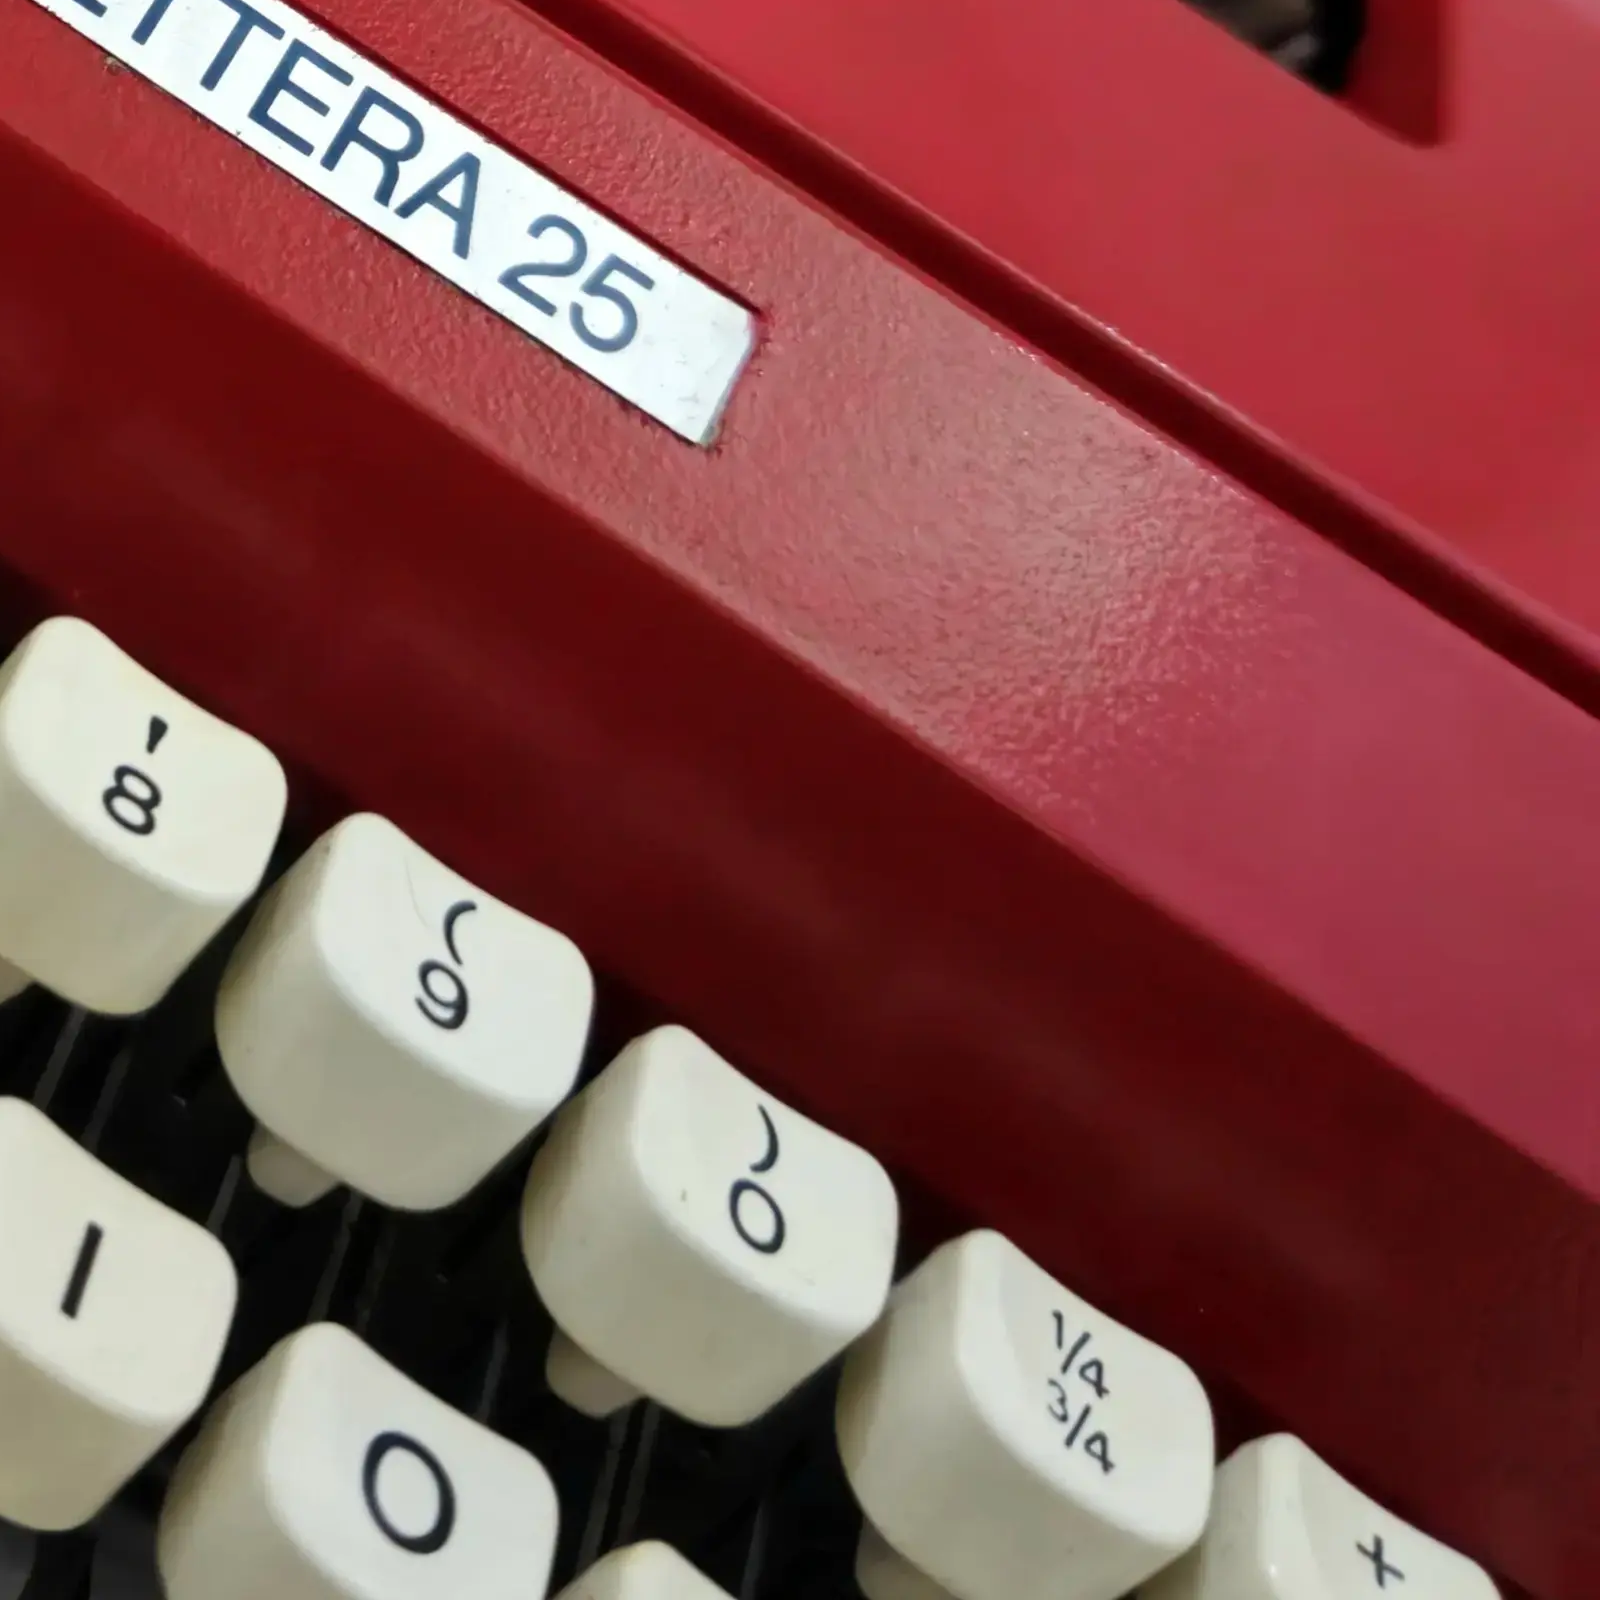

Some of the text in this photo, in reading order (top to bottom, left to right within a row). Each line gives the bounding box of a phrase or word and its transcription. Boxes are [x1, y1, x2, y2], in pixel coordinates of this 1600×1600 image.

[499, 215, 655, 353] 25
[102, 765, 162, 836] 8
[414, 960, 469, 1030] 9
[60, 1222, 104, 1320] I
[362, 1431, 457, 1556] O
[1355, 1535, 1404, 1588] +
